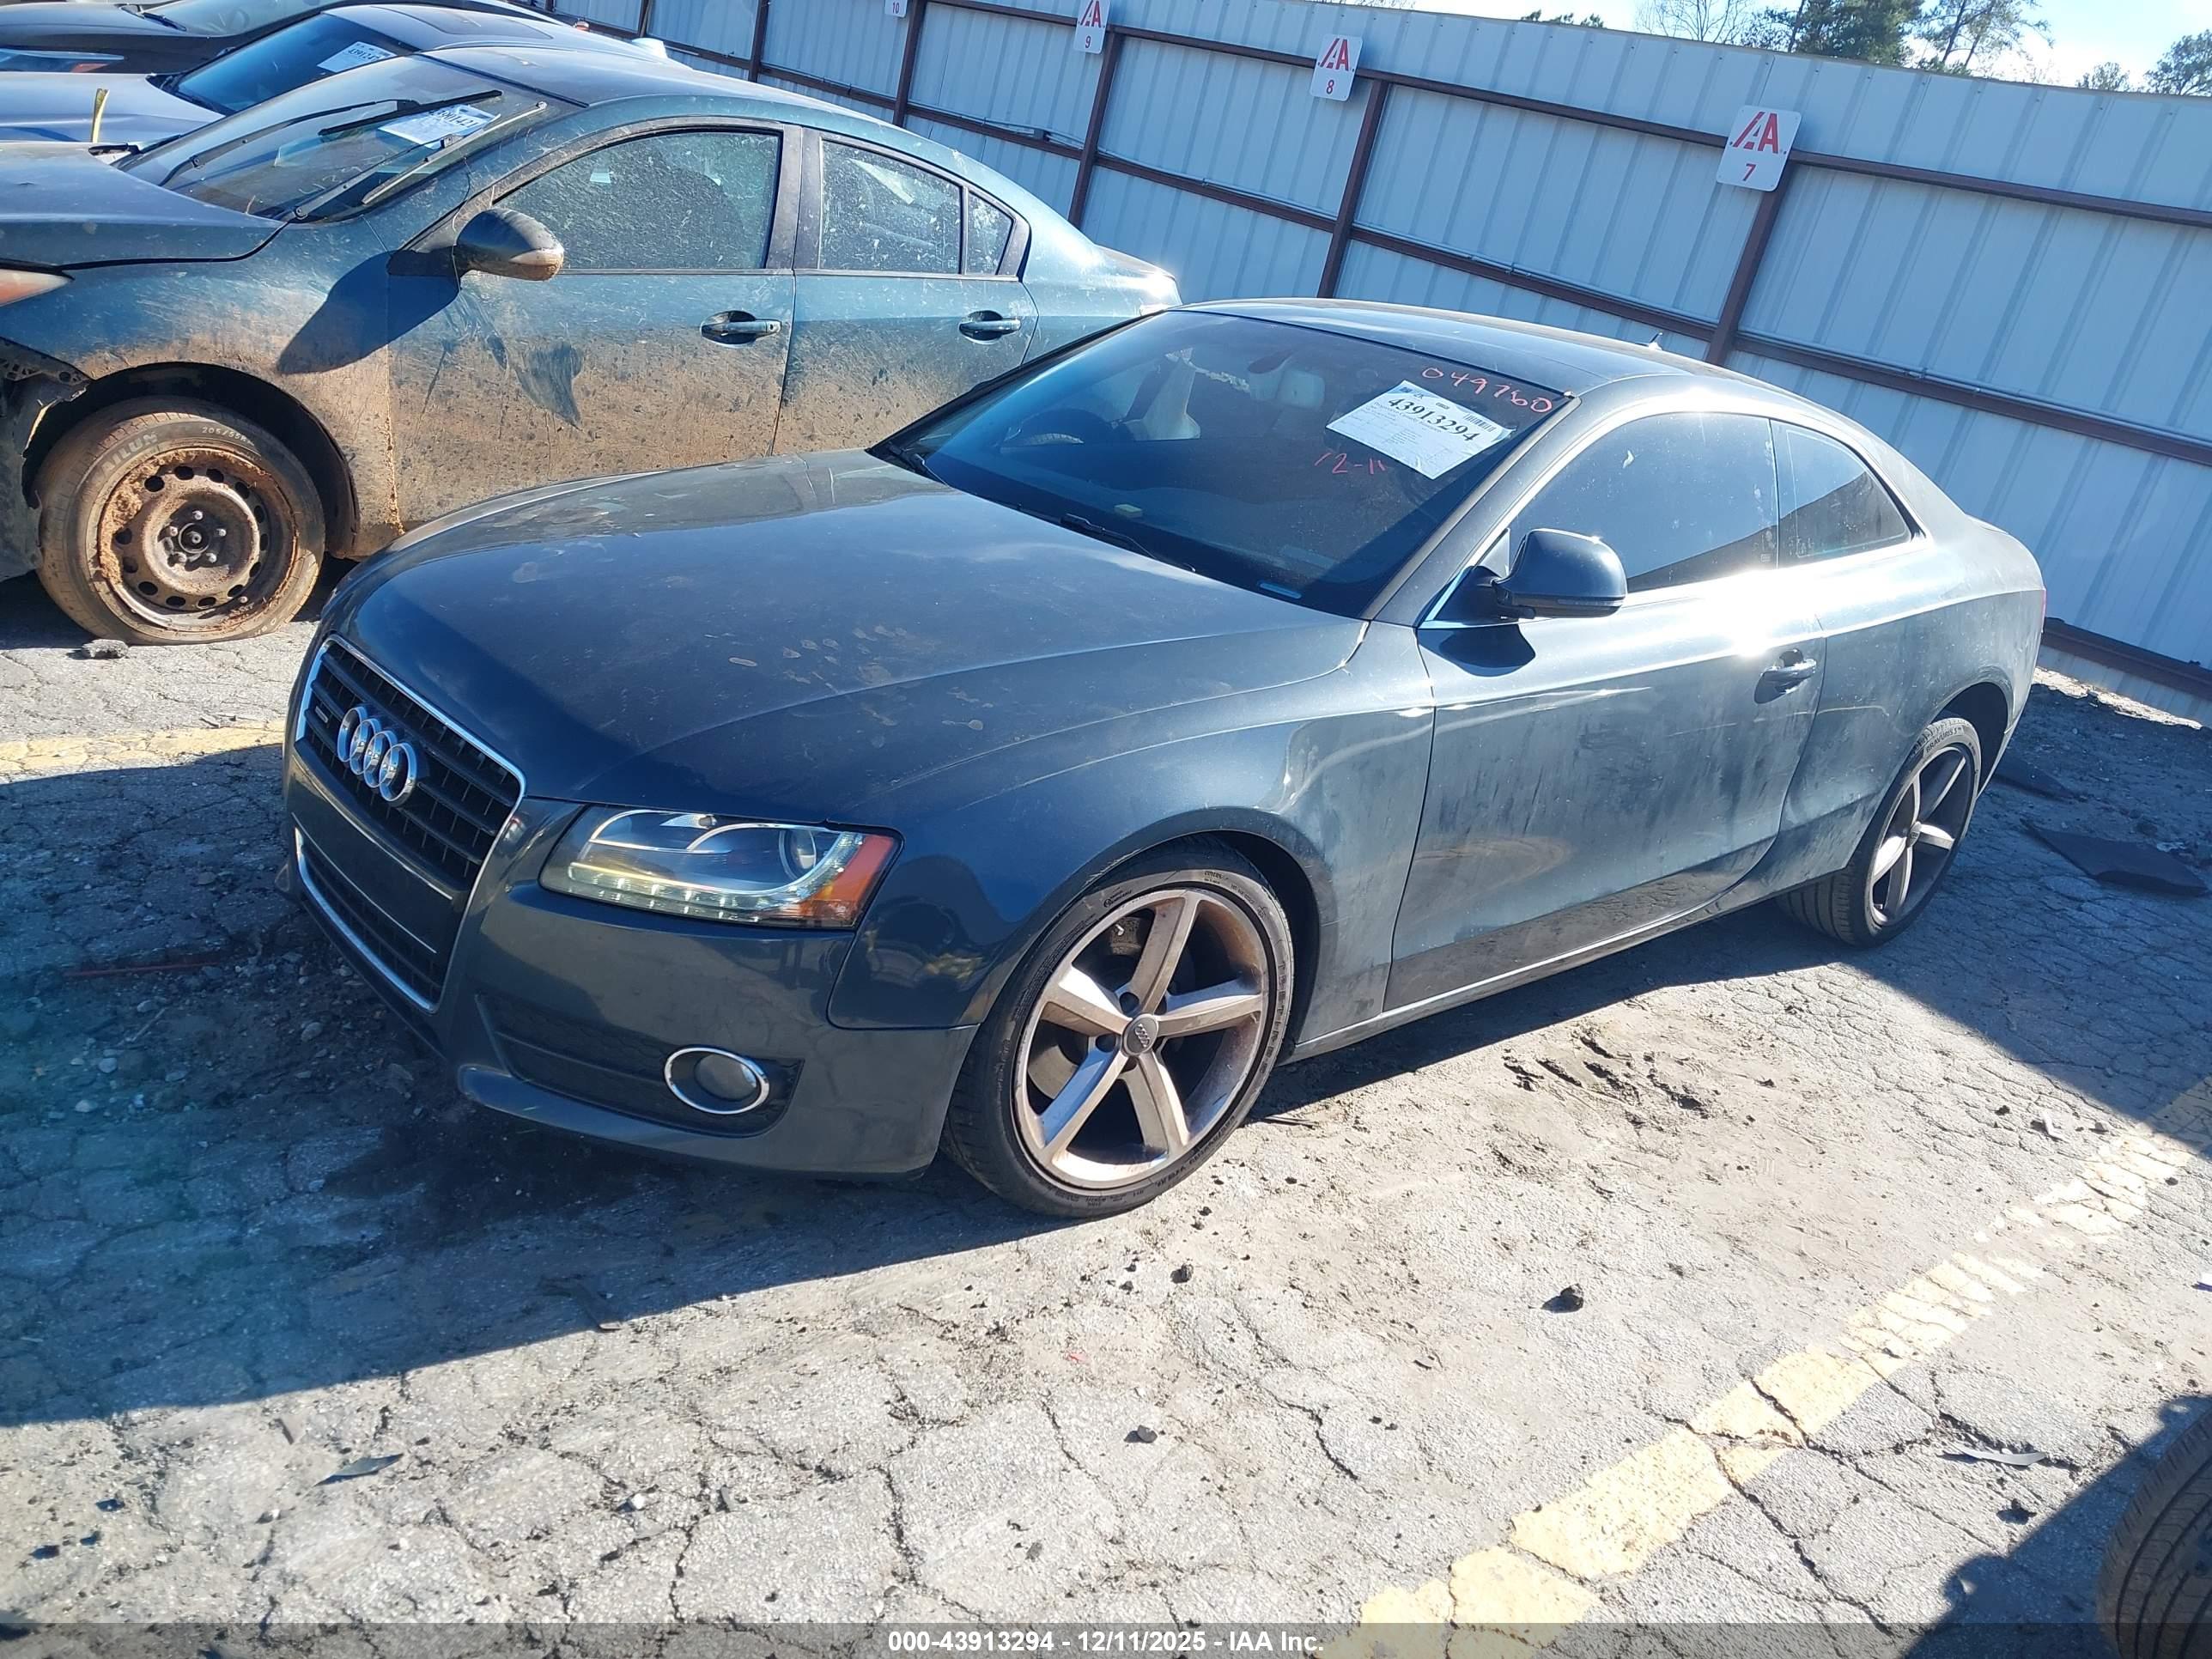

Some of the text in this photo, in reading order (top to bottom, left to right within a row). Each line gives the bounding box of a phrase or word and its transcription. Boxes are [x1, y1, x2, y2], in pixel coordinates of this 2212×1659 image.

[892, 2, 900, 15] 10
[1085, 35, 1091, 49] 9
[1326, 79, 1334, 94] 8
[1741, 162, 1757, 182] 7
[1421, 367, 1553, 413] 049760
[1388, 397, 1482, 442] 43913294
[1926, 728, 1954, 753] BRAVURIS
